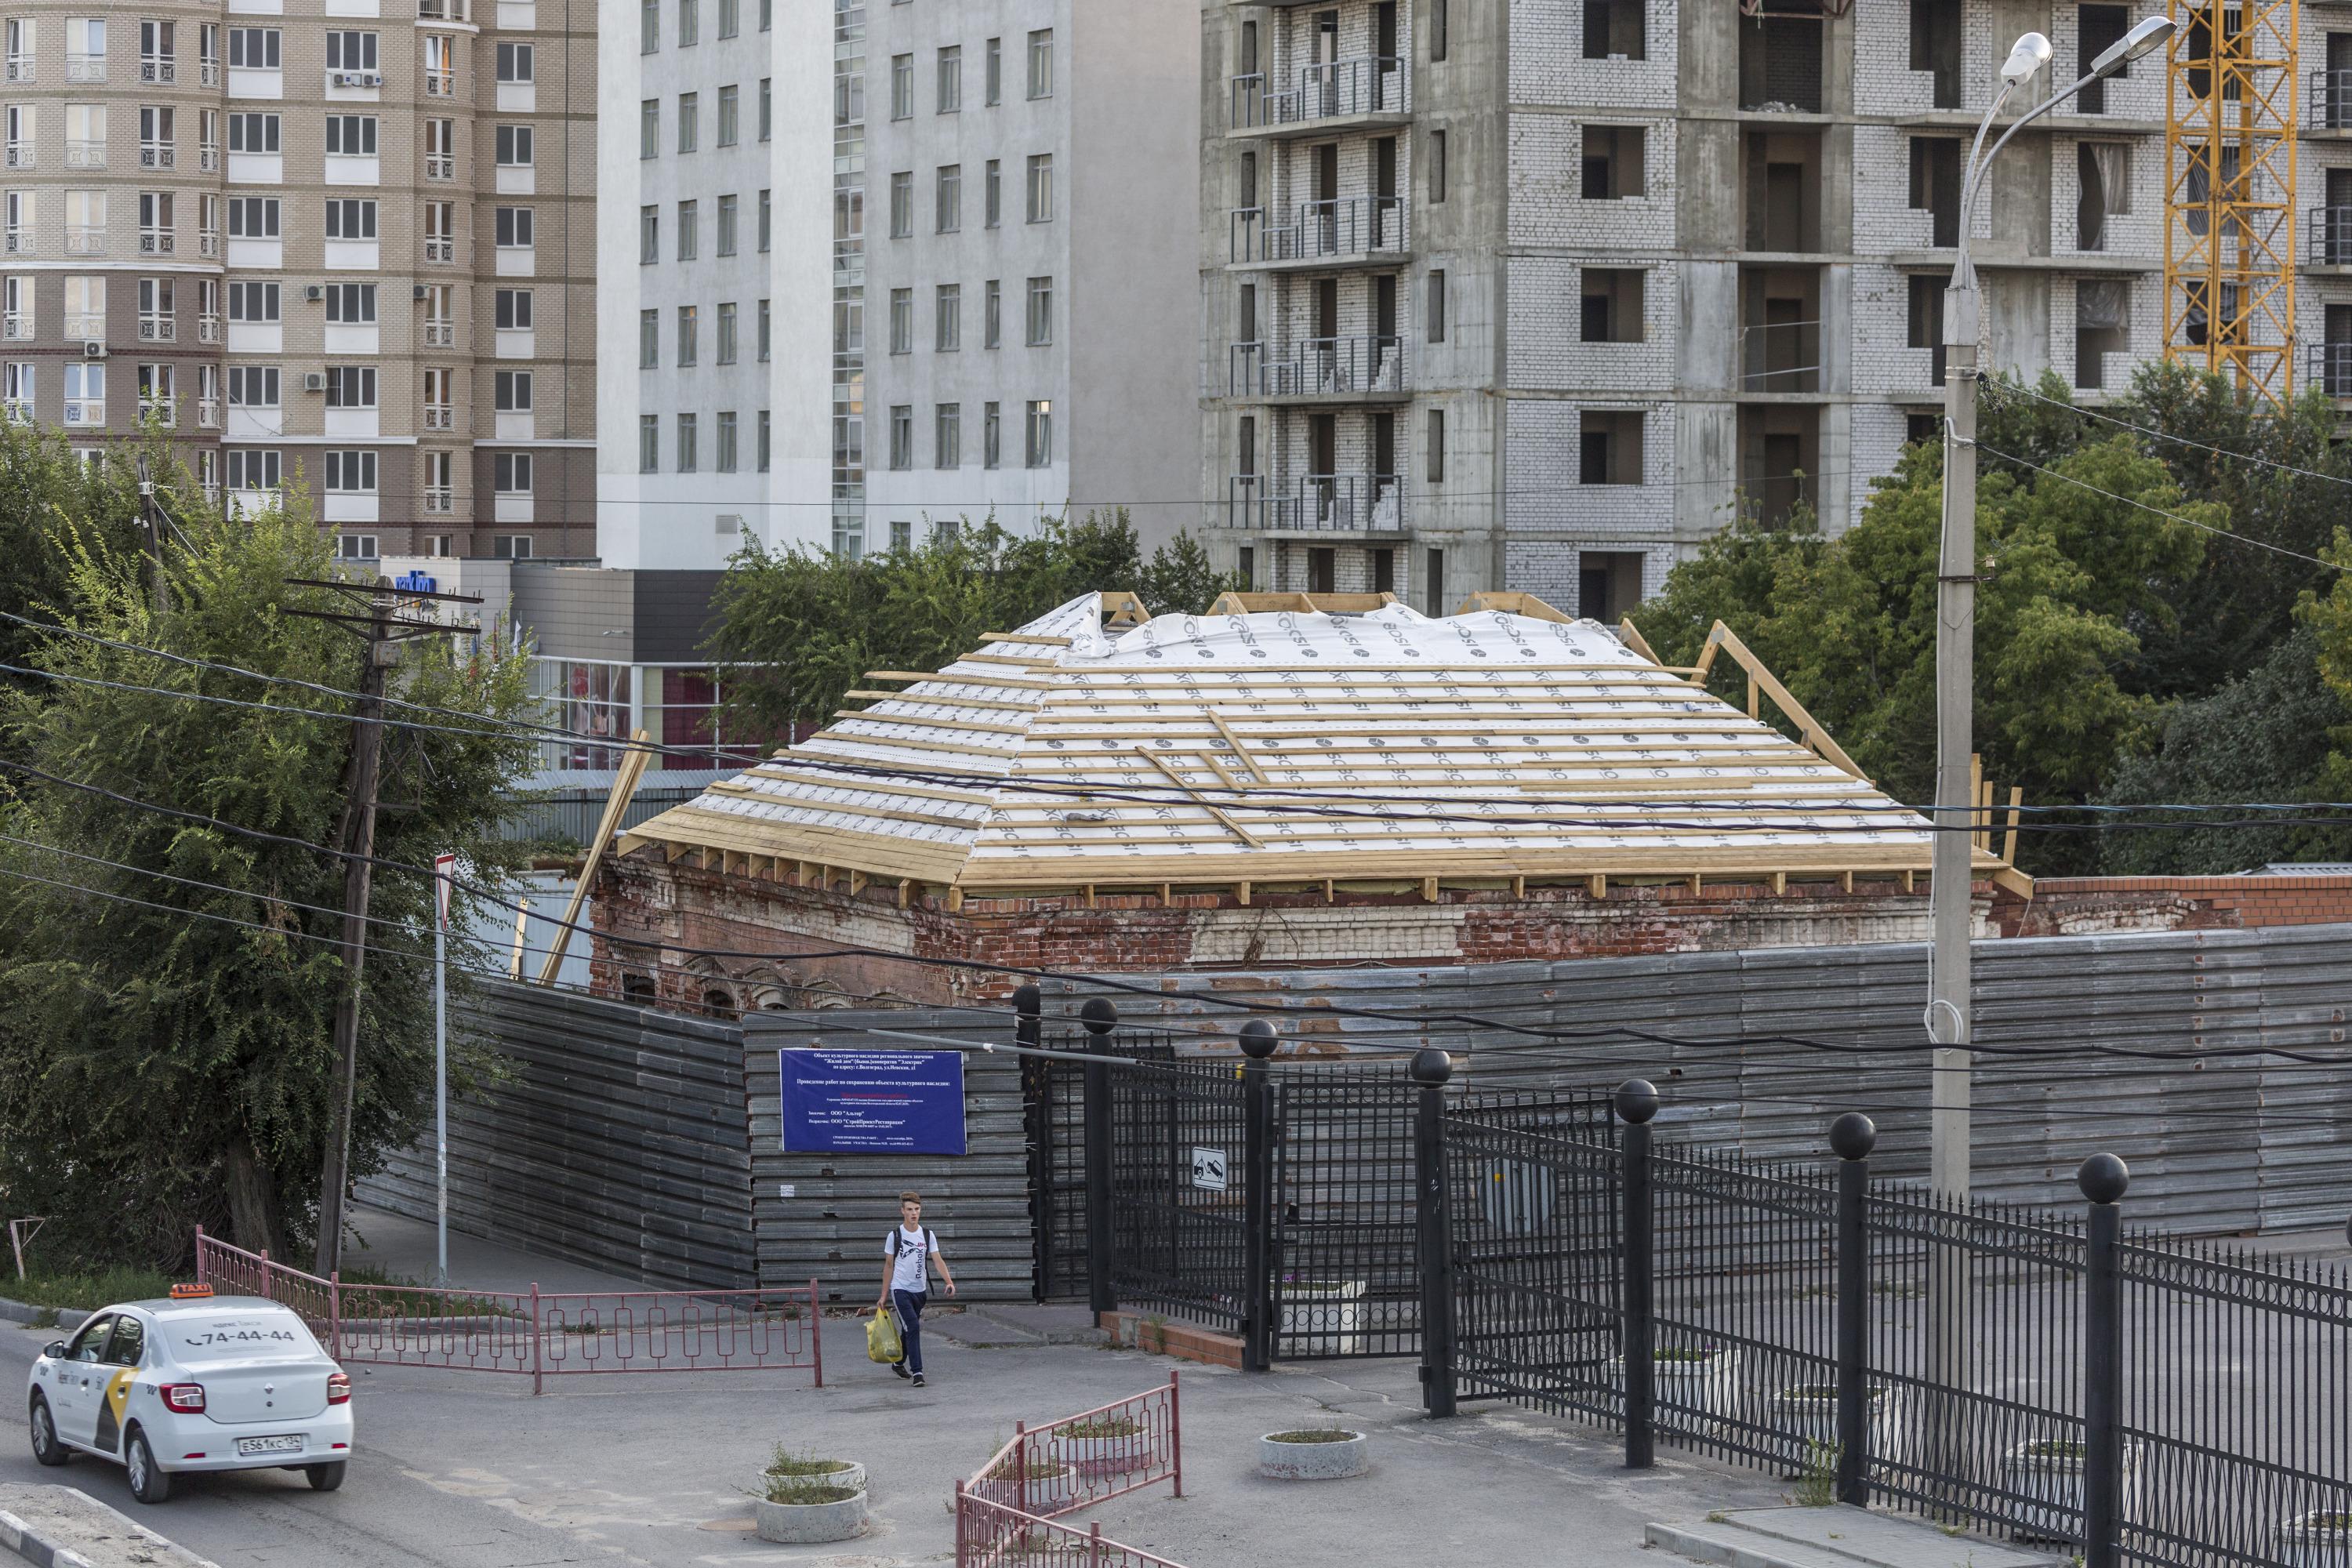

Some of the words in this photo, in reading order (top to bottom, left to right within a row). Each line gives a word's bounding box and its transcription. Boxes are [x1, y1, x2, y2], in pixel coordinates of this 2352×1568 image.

[915, 1247, 924, 1279] Reebok
[179, 1283, 209, 1292] TAXI
[201, 1330, 296, 1345] 74-44-44
